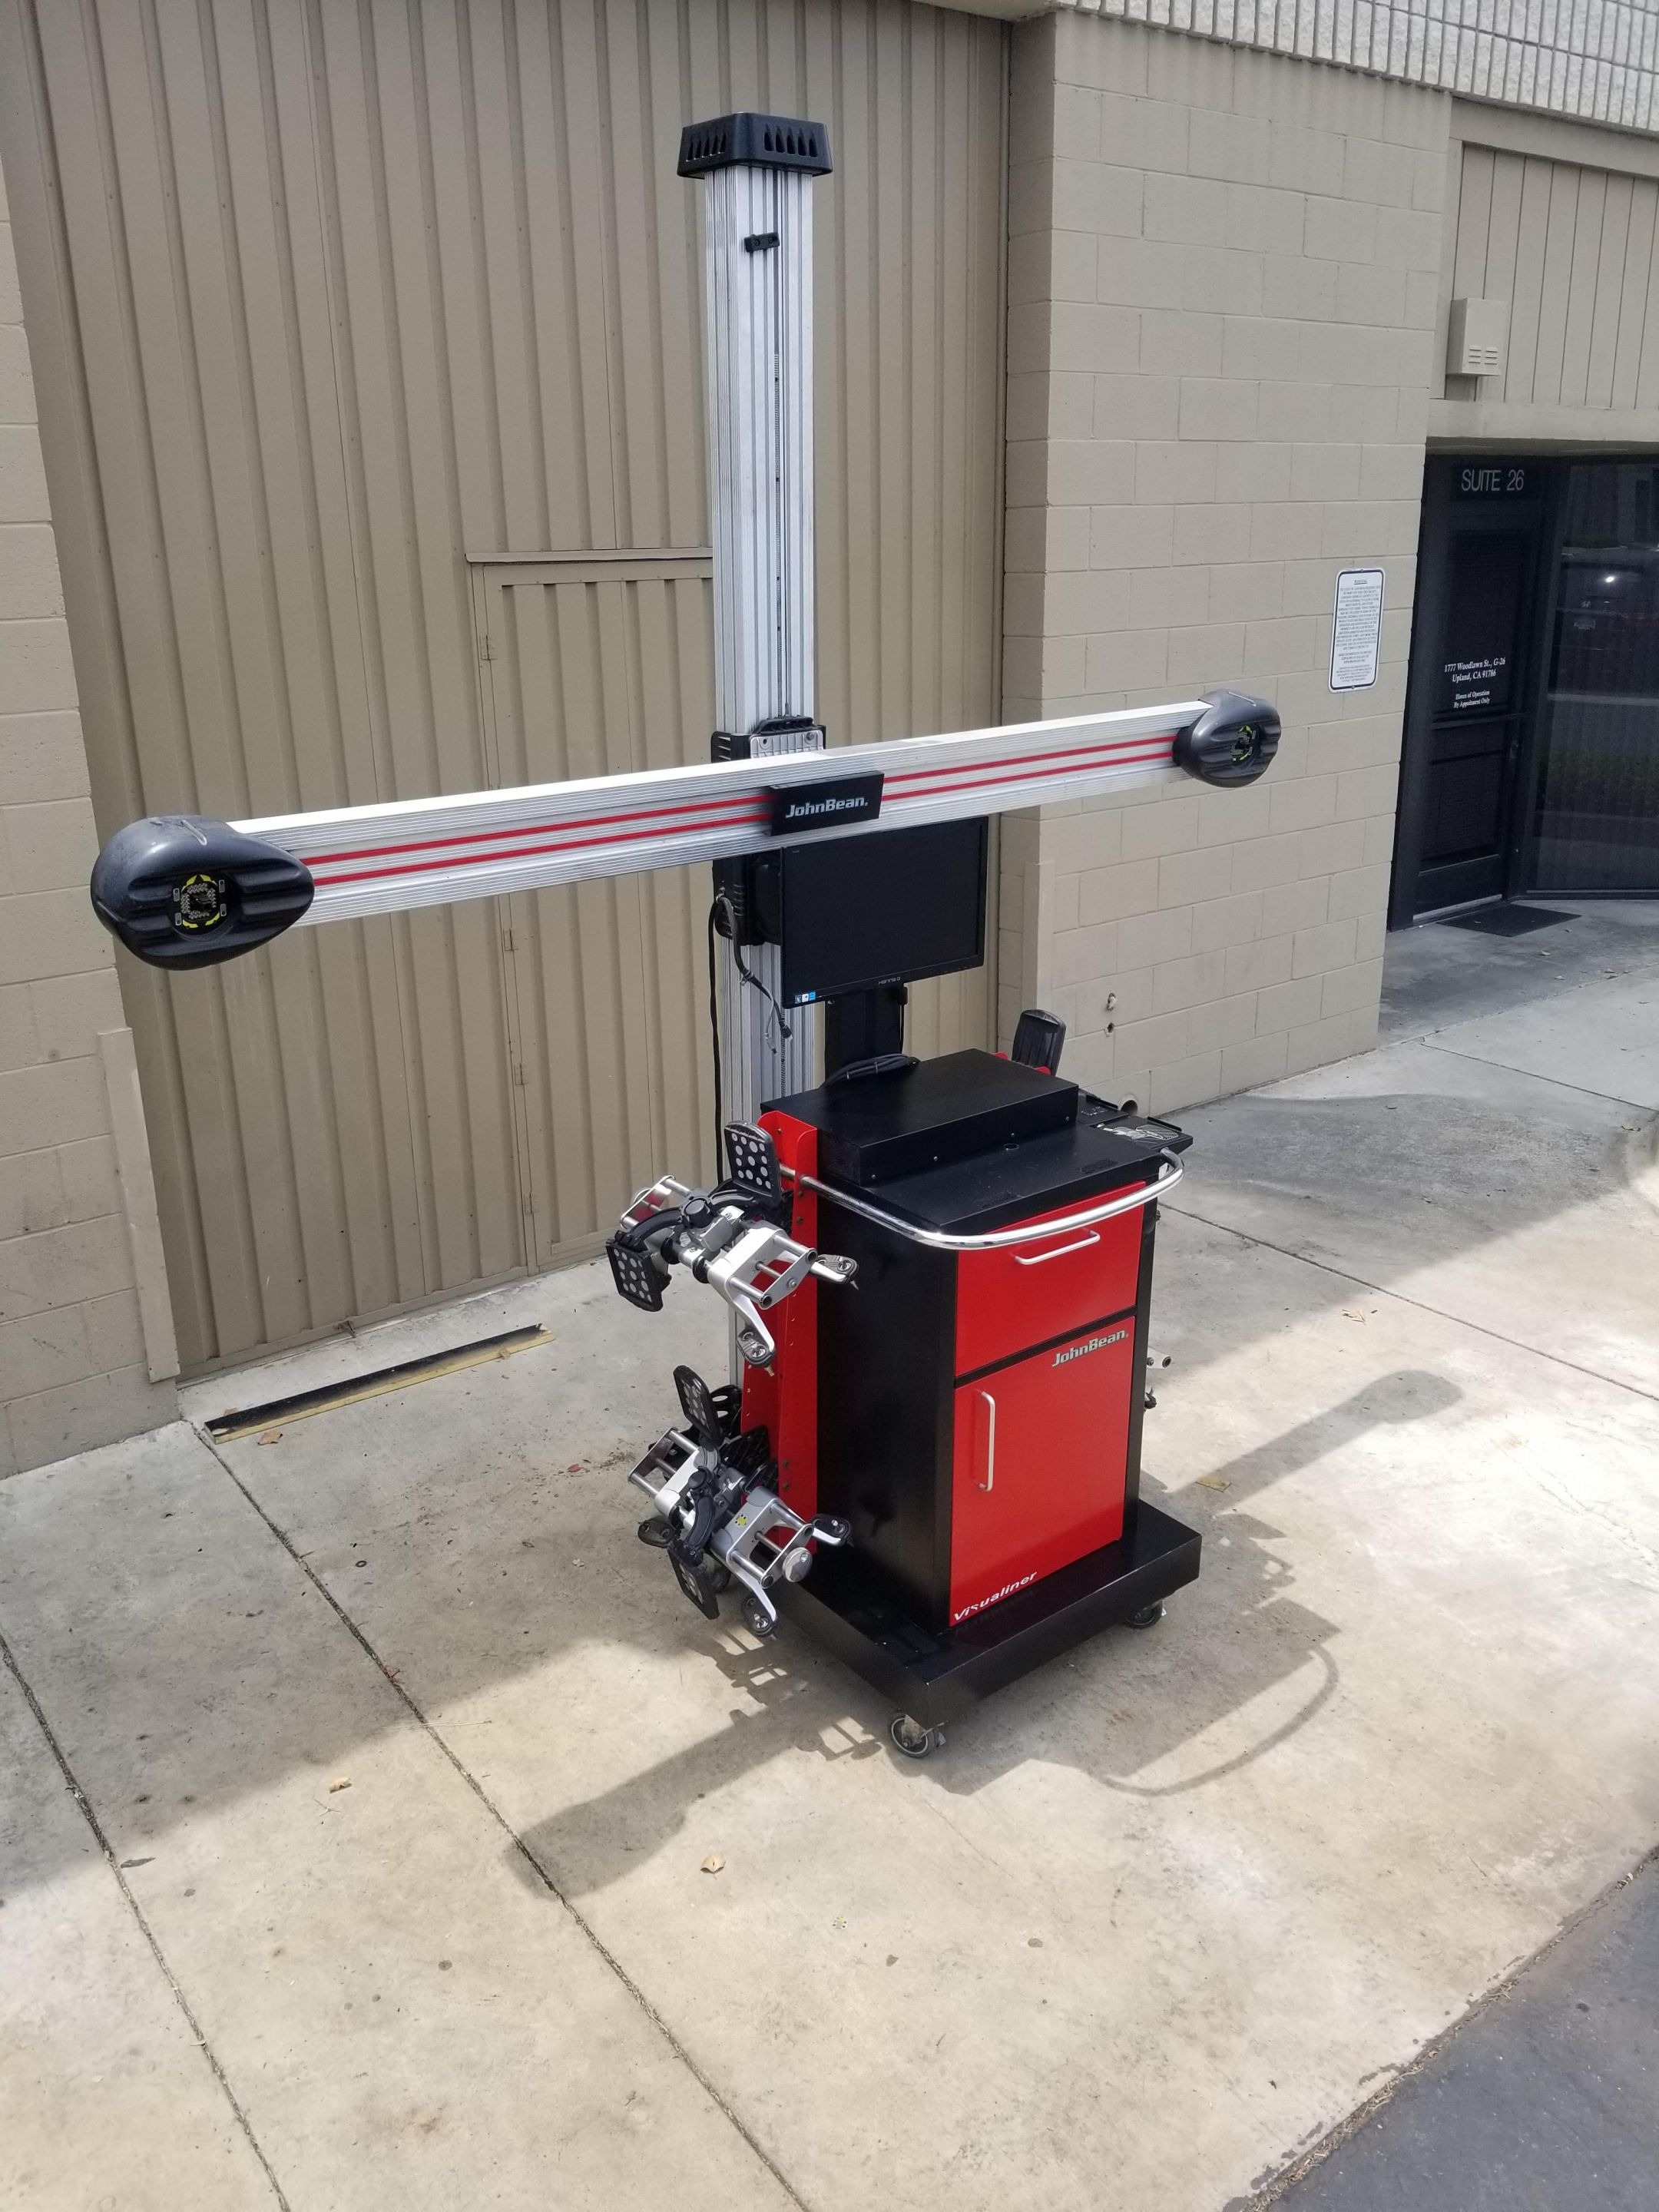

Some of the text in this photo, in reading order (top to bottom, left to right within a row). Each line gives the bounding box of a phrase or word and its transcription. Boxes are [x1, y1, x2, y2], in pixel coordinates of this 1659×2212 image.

[1461, 469, 1525, 492] SUITE 26
[1444, 663, 1456, 672] 1777
[1457, 661, 1483, 671] Woodlawn
[1493, 657, 1506, 666] G-26
[1452, 668, 1496, 683] Upland, CA 91786
[954, 1571, 1038, 1621] Visualiner
